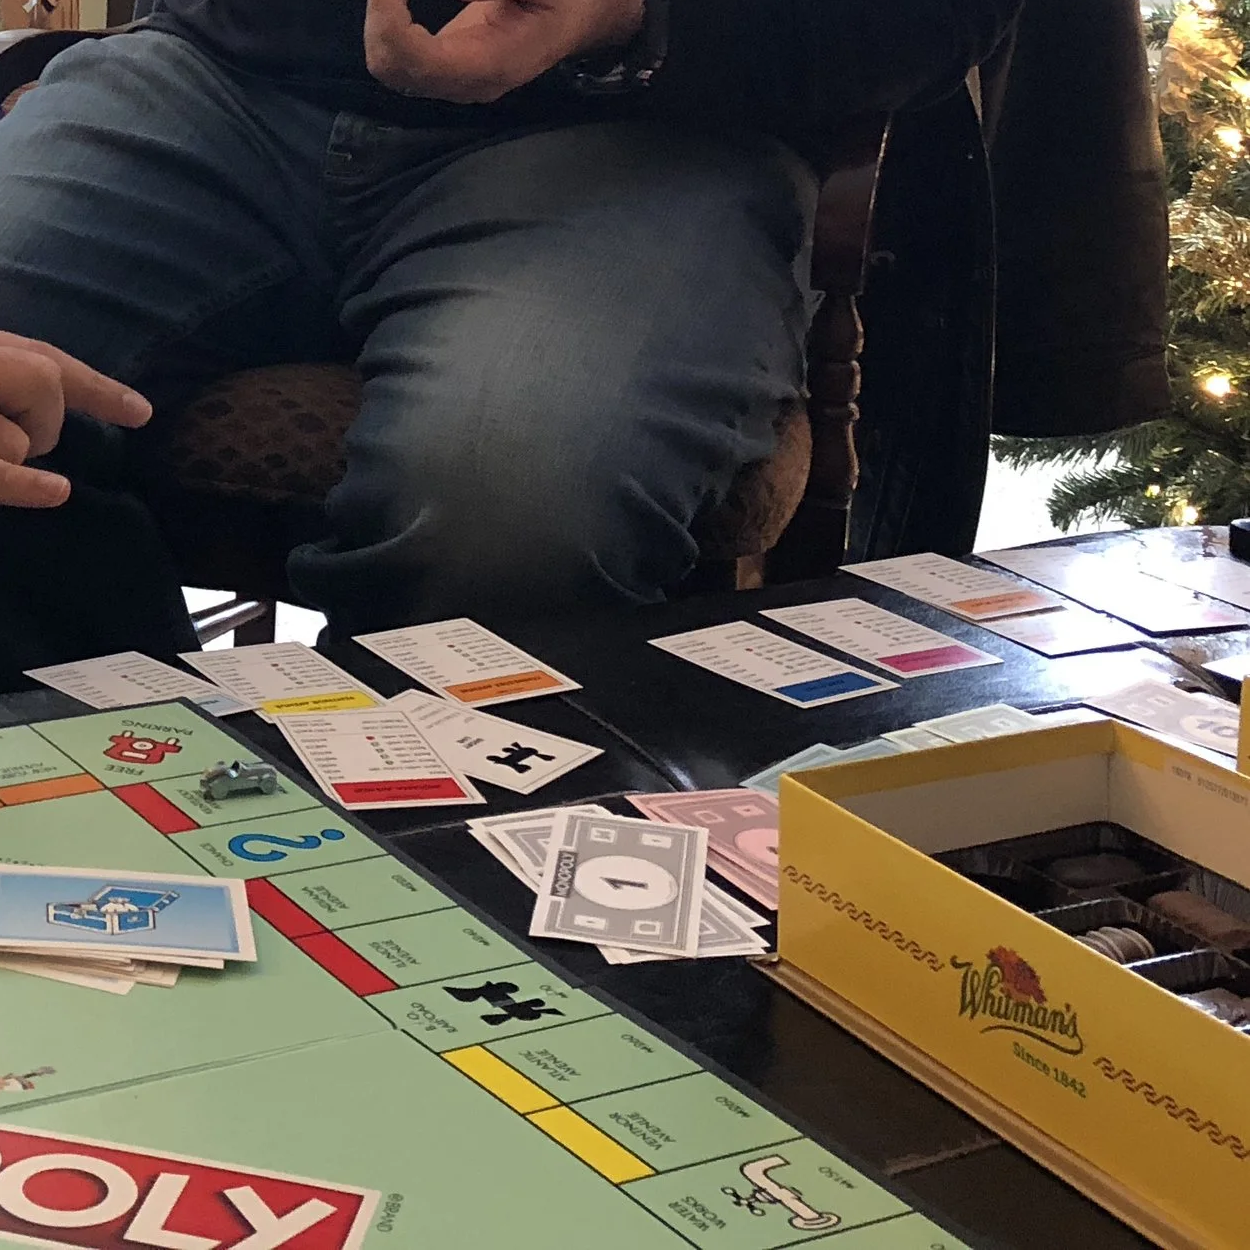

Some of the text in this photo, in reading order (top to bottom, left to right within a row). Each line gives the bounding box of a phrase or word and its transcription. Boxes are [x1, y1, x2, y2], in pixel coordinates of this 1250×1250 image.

[122, 720, 193, 736] PARKING
[104, 764, 144, 776] FREE
[554, 851, 577, 898] MONOPOLY
[599, 876, 649, 891] 1
[951, 956, 1082, 1046] Whitman's
[518, 1050, 570, 1082] ATLANTIC
[534, 1048, 580, 1077] AVENUE
[1012, 1041, 1087, 1099] Since 1842
[609, 1111, 662, 1150] VENTNOR
[626, 1111, 676, 1144] AVENUE
[668, 1201, 710, 1231] WATER
[680, 1196, 726, 1229] WORKS
